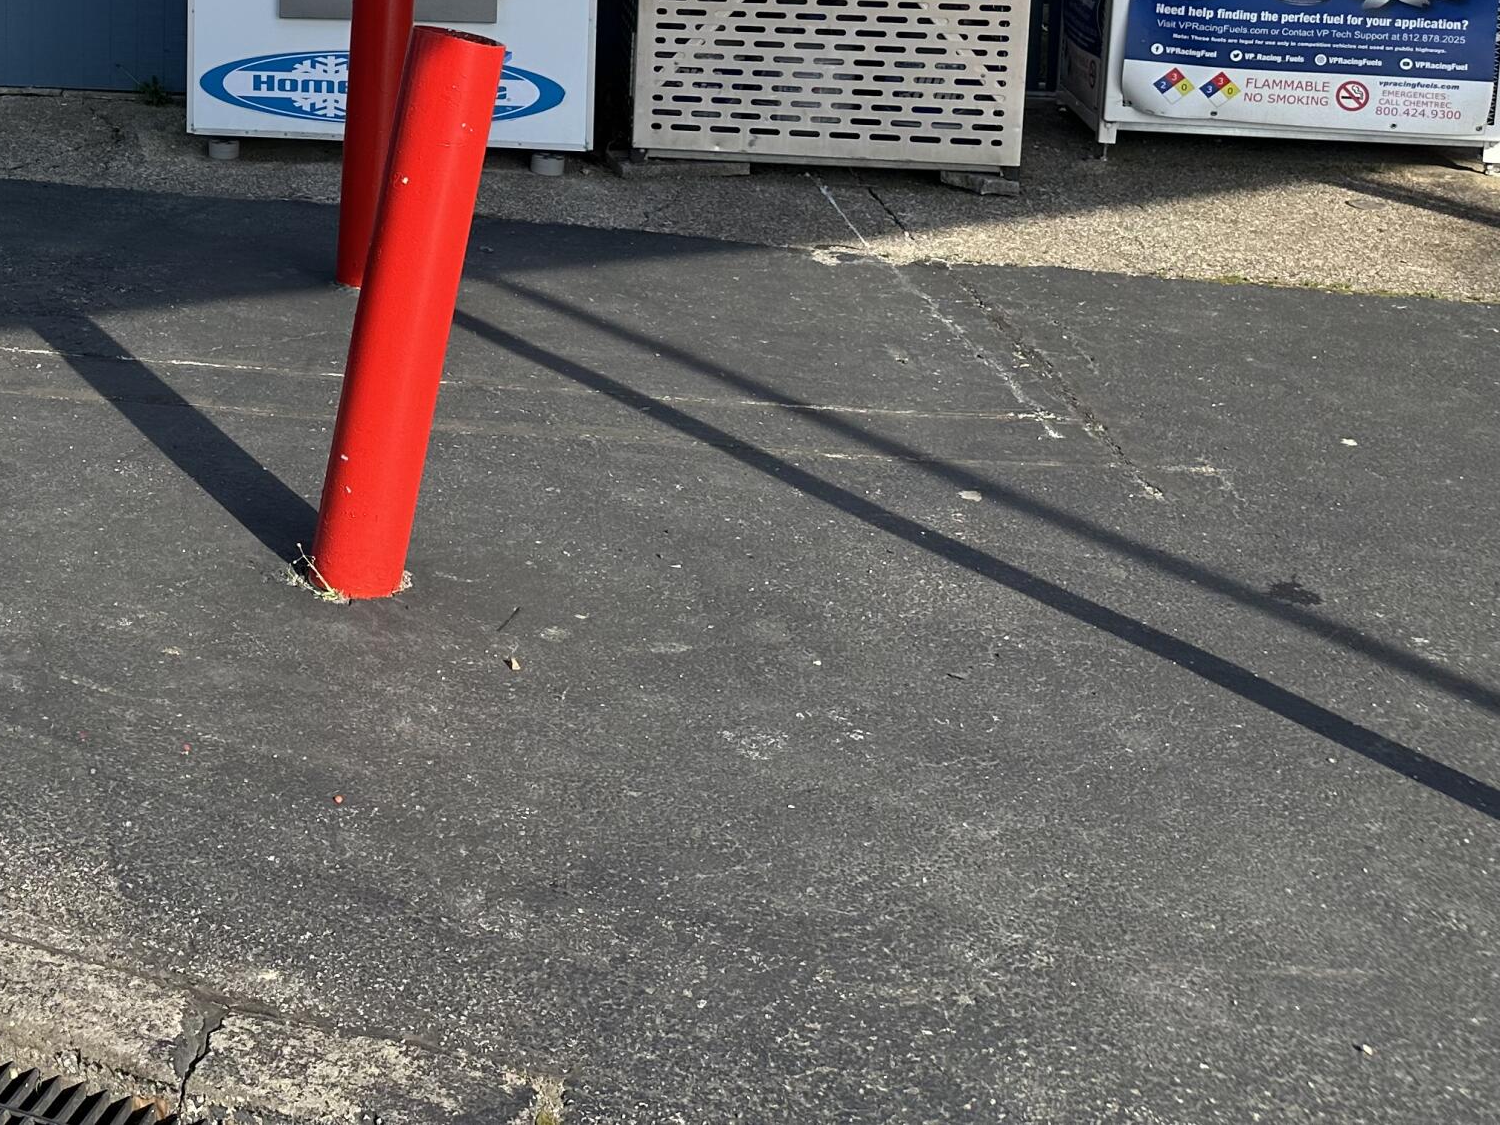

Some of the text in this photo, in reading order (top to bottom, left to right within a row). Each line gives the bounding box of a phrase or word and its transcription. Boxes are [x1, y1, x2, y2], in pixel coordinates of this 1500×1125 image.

[1156, 3, 1468, 30] Need help finding the perfect fuel for your application?
[1157, 19, 1176, 28] Visit
[1179, 21, 1268, 35] VPRacingFuels.com
[1282, 28, 1314, 37] Contact
[1332, 30, 1351, 38] Tech
[1354, 31, 1388, 41] Support
[1166, 47, 1217, 58] VPRacingFuel
[1329, 57, 1382, 66] VPRacingFuels
[1415, 61, 1468, 71] VPRacingFuel
[1172, 73, 1177, 81] 3
[1246, 78, 1330, 92] FLAMMABLE
[1379, 81, 1460, 90] vpracingfuels.com
[1244, 93, 1329, 106] NO SMOKING
[1403, 100, 1452, 108] CHEMTREC
[1376, 107, 1461, 120] 800.424.9300
